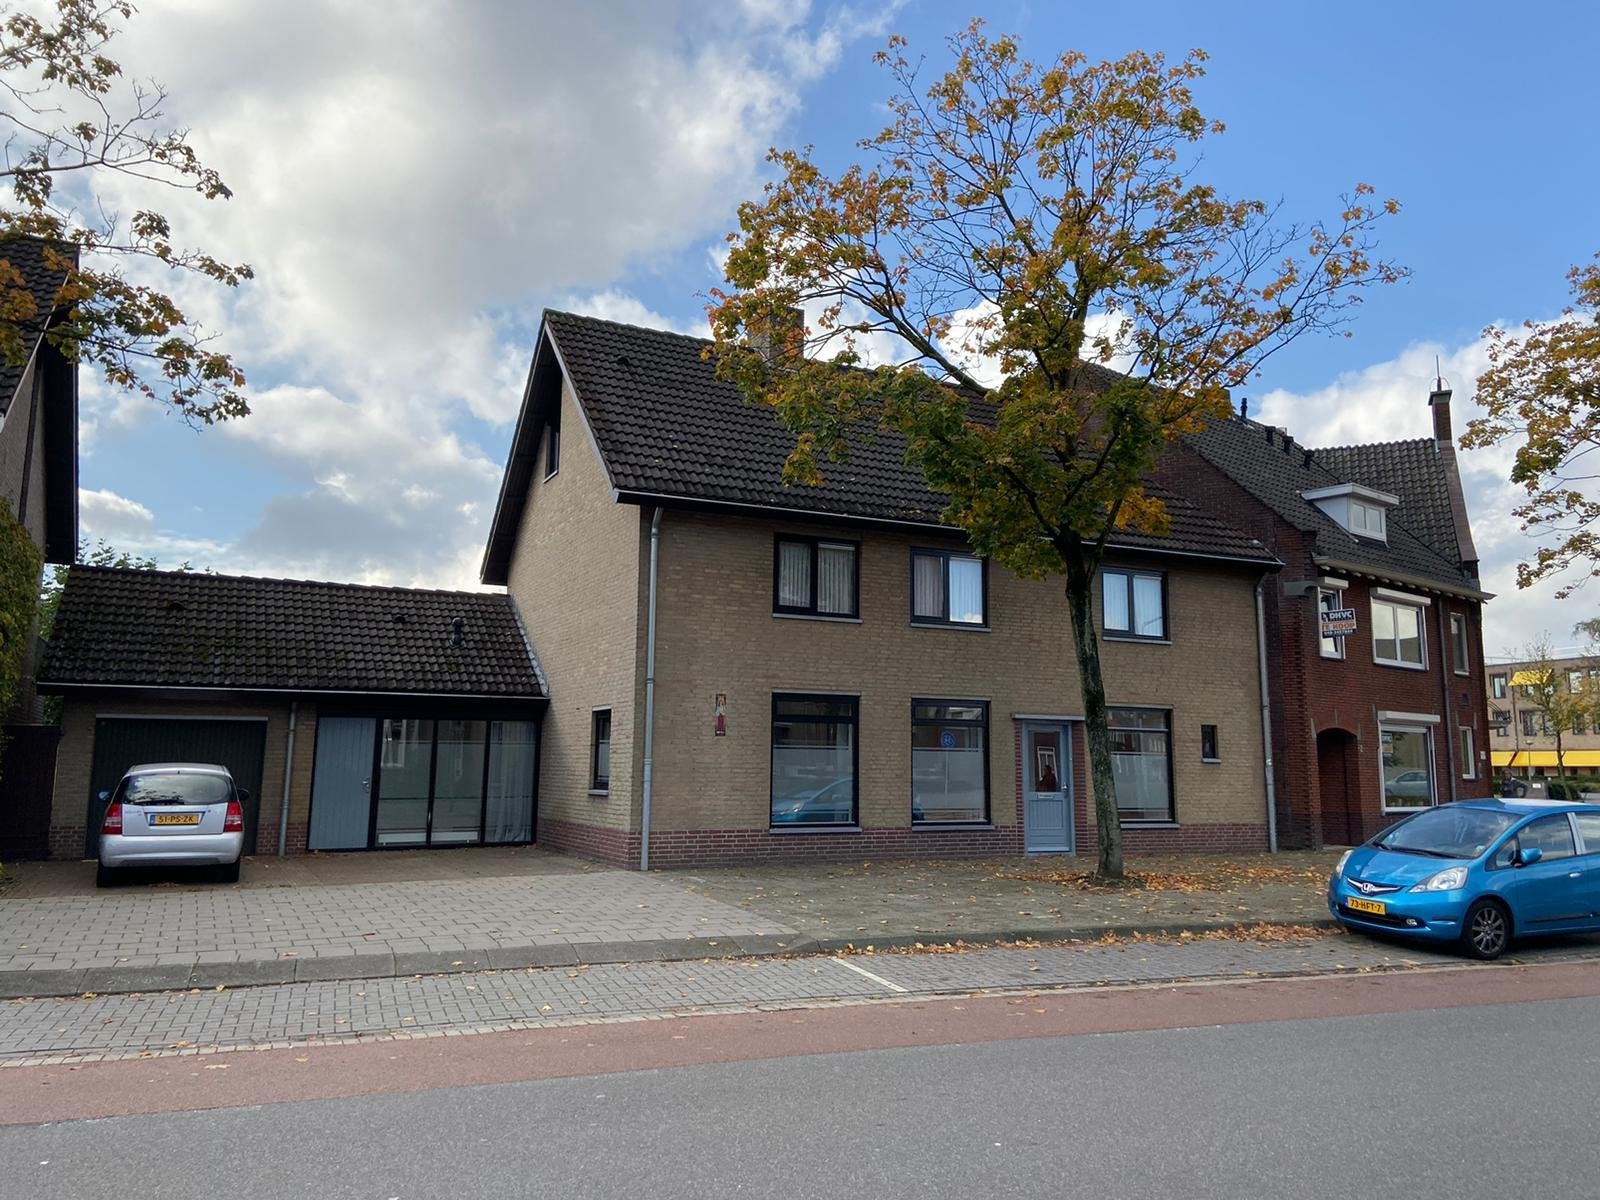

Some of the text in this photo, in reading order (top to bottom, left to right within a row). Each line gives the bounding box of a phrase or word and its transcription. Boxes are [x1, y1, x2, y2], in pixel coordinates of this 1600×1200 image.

[1329, 611, 1352, 619] DHVC
[158, 815, 194, 823] 51-PS-ZK
[1350, 899, 1381, 912] 73-HFT-7
